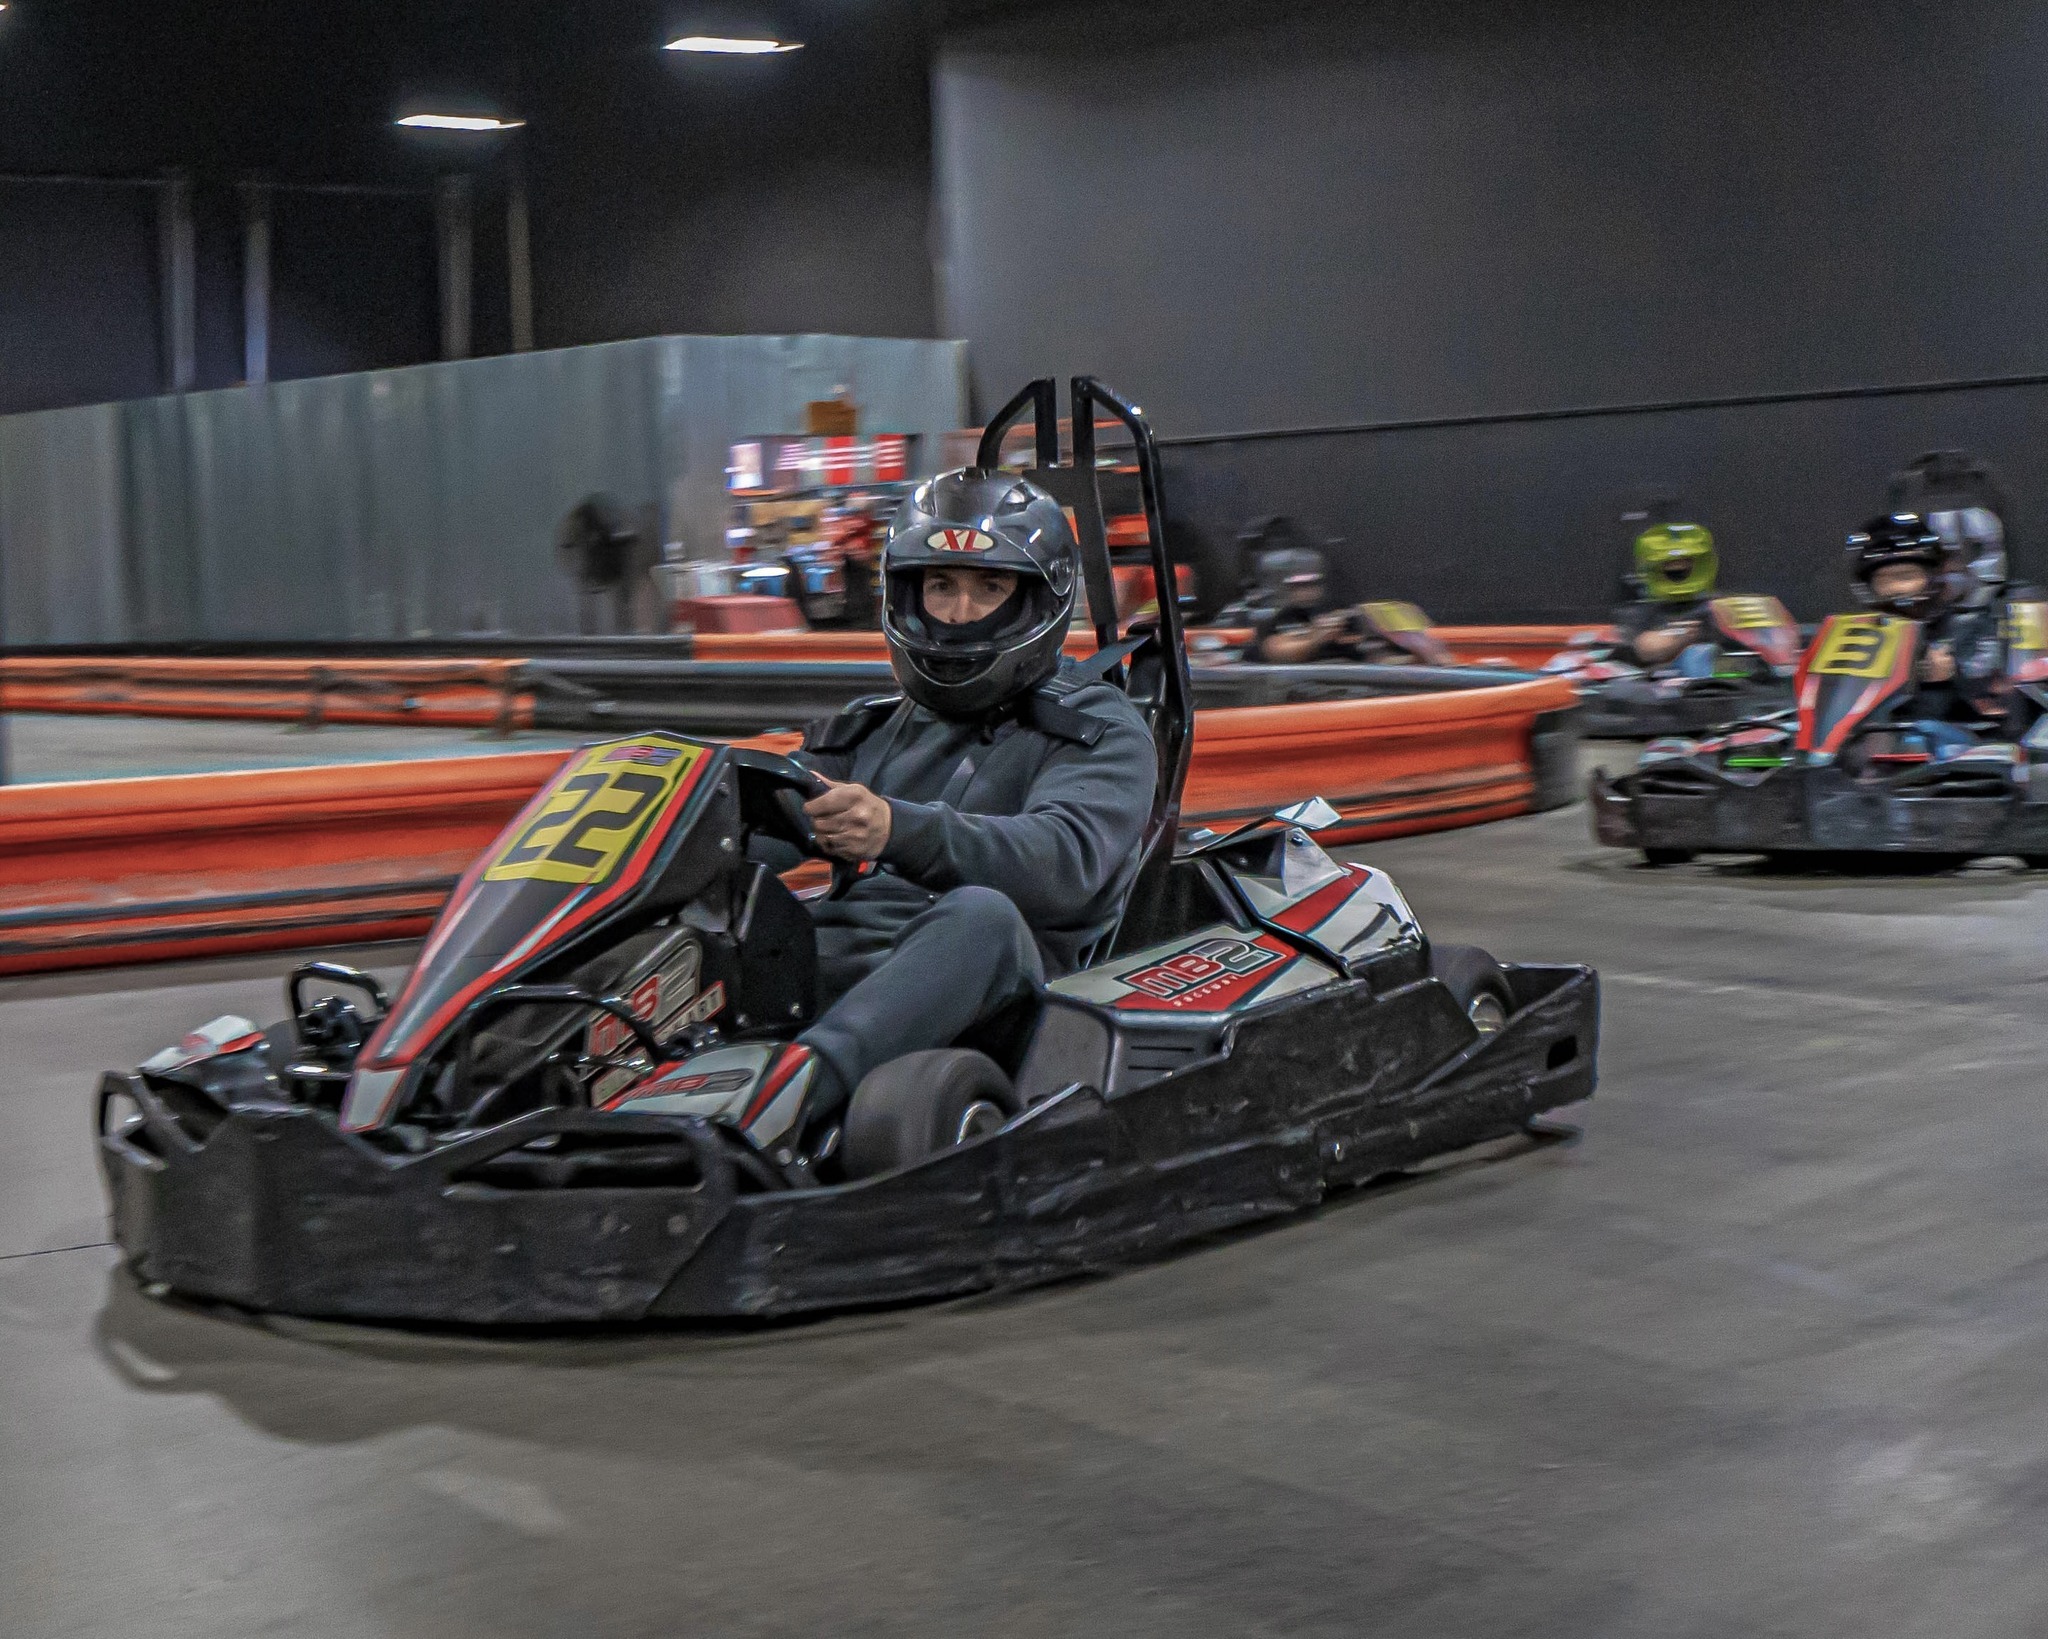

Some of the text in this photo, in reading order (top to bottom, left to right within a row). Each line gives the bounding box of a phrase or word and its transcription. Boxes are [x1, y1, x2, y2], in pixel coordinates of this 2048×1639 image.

[1826, 627, 1886, 670] 3
[499, 772, 667, 868] 22
[1123, 938, 1274, 998] MB2
